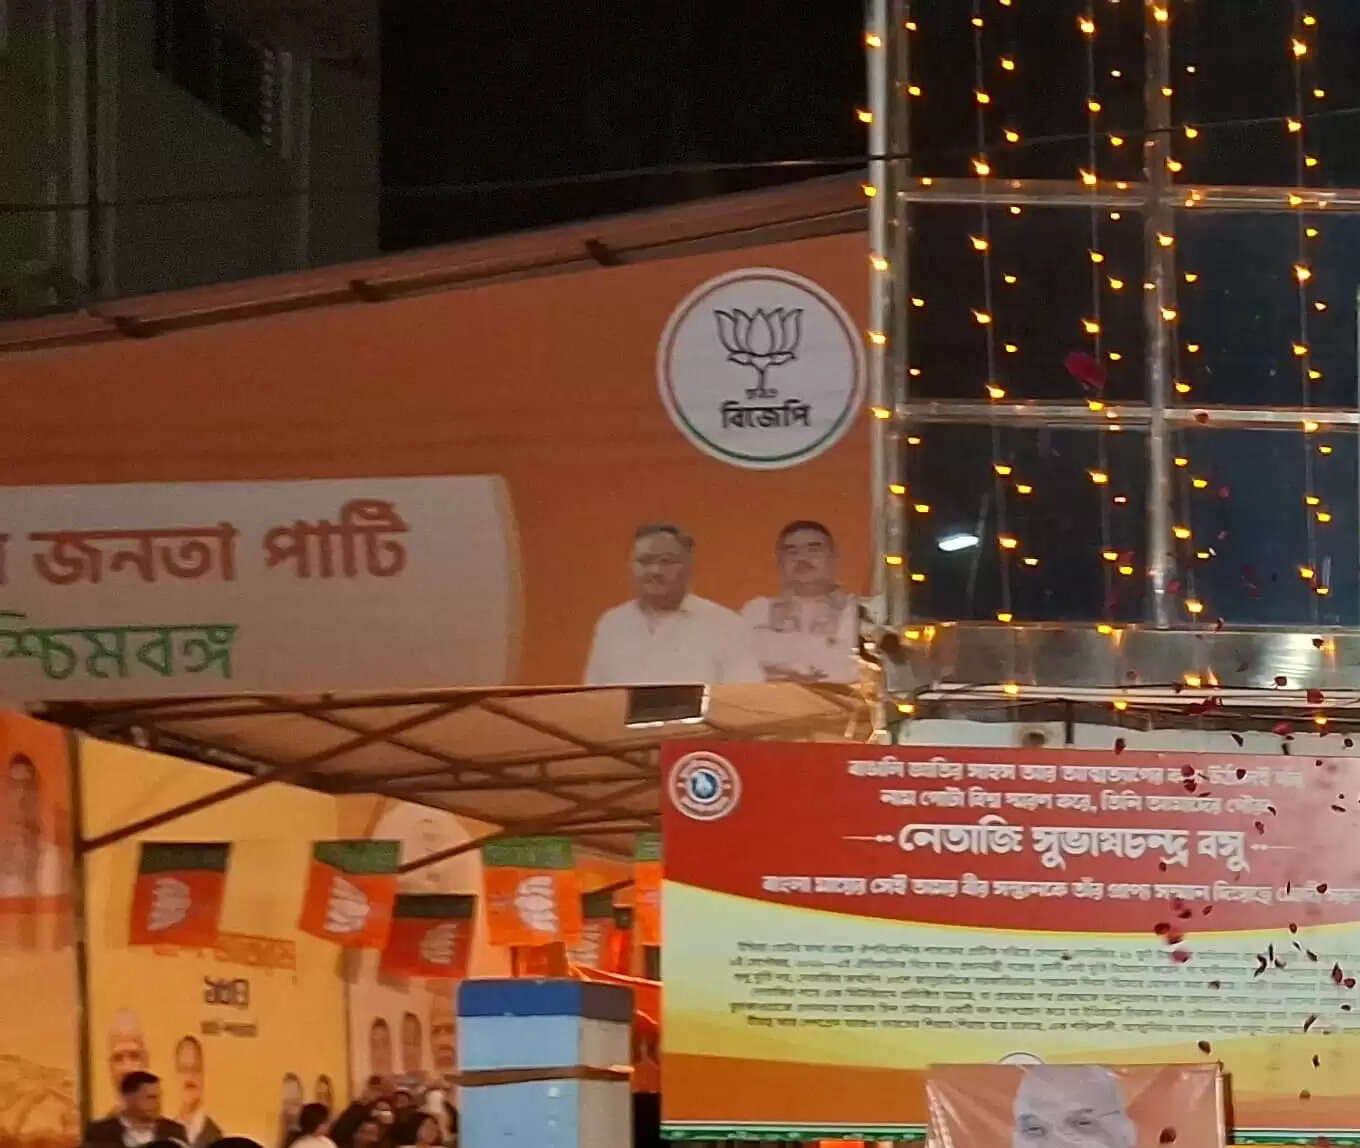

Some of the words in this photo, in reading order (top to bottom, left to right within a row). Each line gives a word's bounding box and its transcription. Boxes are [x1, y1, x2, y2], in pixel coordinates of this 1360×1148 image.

[720, 398, 812, 428] বিজেপি
[28, 521, 241, 585] জনতা
[898, 814, 1024, 856] নেতাজি
[1031, 826, 1190, 871] সুভাষচন্দ্র
[1196, 830, 1250, 874] বসু
